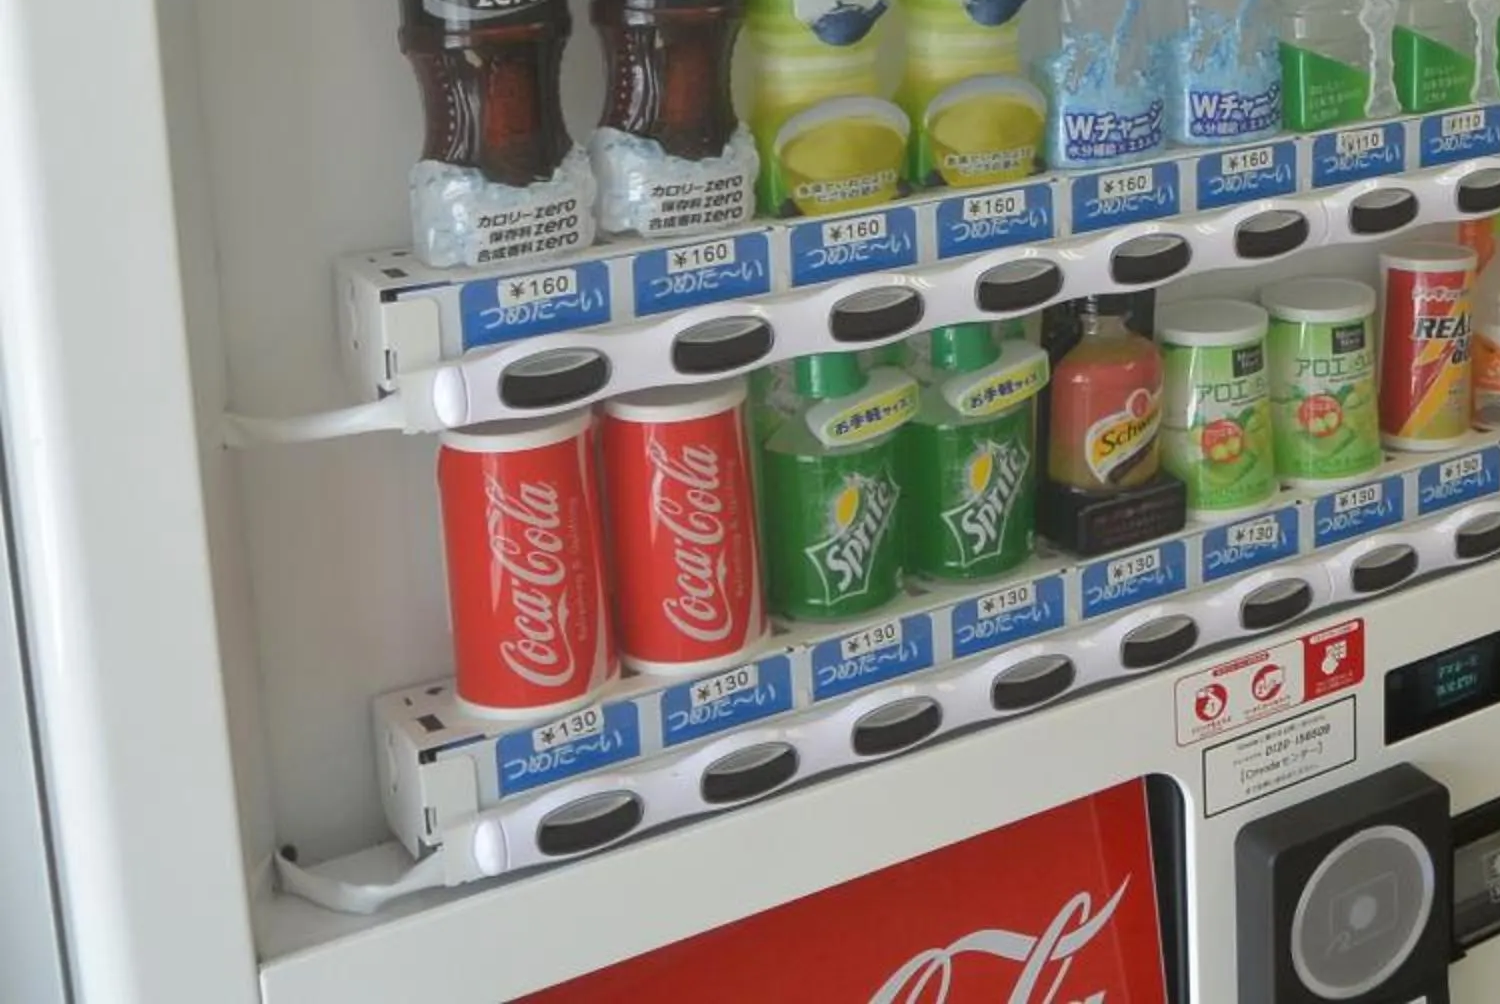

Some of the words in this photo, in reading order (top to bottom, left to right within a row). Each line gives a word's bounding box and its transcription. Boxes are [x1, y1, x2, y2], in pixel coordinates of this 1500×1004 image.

[1191, 81, 1281, 118] Wチャージ
[1065, 98, 1164, 142] Wチャージ
[1228, 150, 1270, 171] ¥160
[1103, 174, 1147, 193] ¥160
[968, 197, 1015, 216] ¥160
[828, 219, 880, 242] ¥160
[673, 245, 728, 268] ¥160
[509, 276, 569, 299] ¥160
[651, 258, 764, 298] つめた～い
[480, 290, 604, 330] つめた～い
[969, 371, 1038, 409] お手軽サイズ
[835, 398, 912, 435] お手軽サイズ
[961, 444, 1022, 554] Sprite
[1338, 489, 1375, 507] ¥130
[651, 435, 734, 642] Coca-Cola
[825, 478, 892, 591] Sprite
[1235, 525, 1273, 543] ¥130
[485, 472, 576, 687] Coca-Cola
[1112, 553, 1155, 579] ¥130
[981, 587, 1028, 612] ¥130
[848, 624, 895, 652] ¥130
[695, 671, 749, 702] ¥130
[668, 683, 776, 731] つめた～い
[540, 710, 597, 744] ¥130
[503, 729, 624, 779] つめた～い
